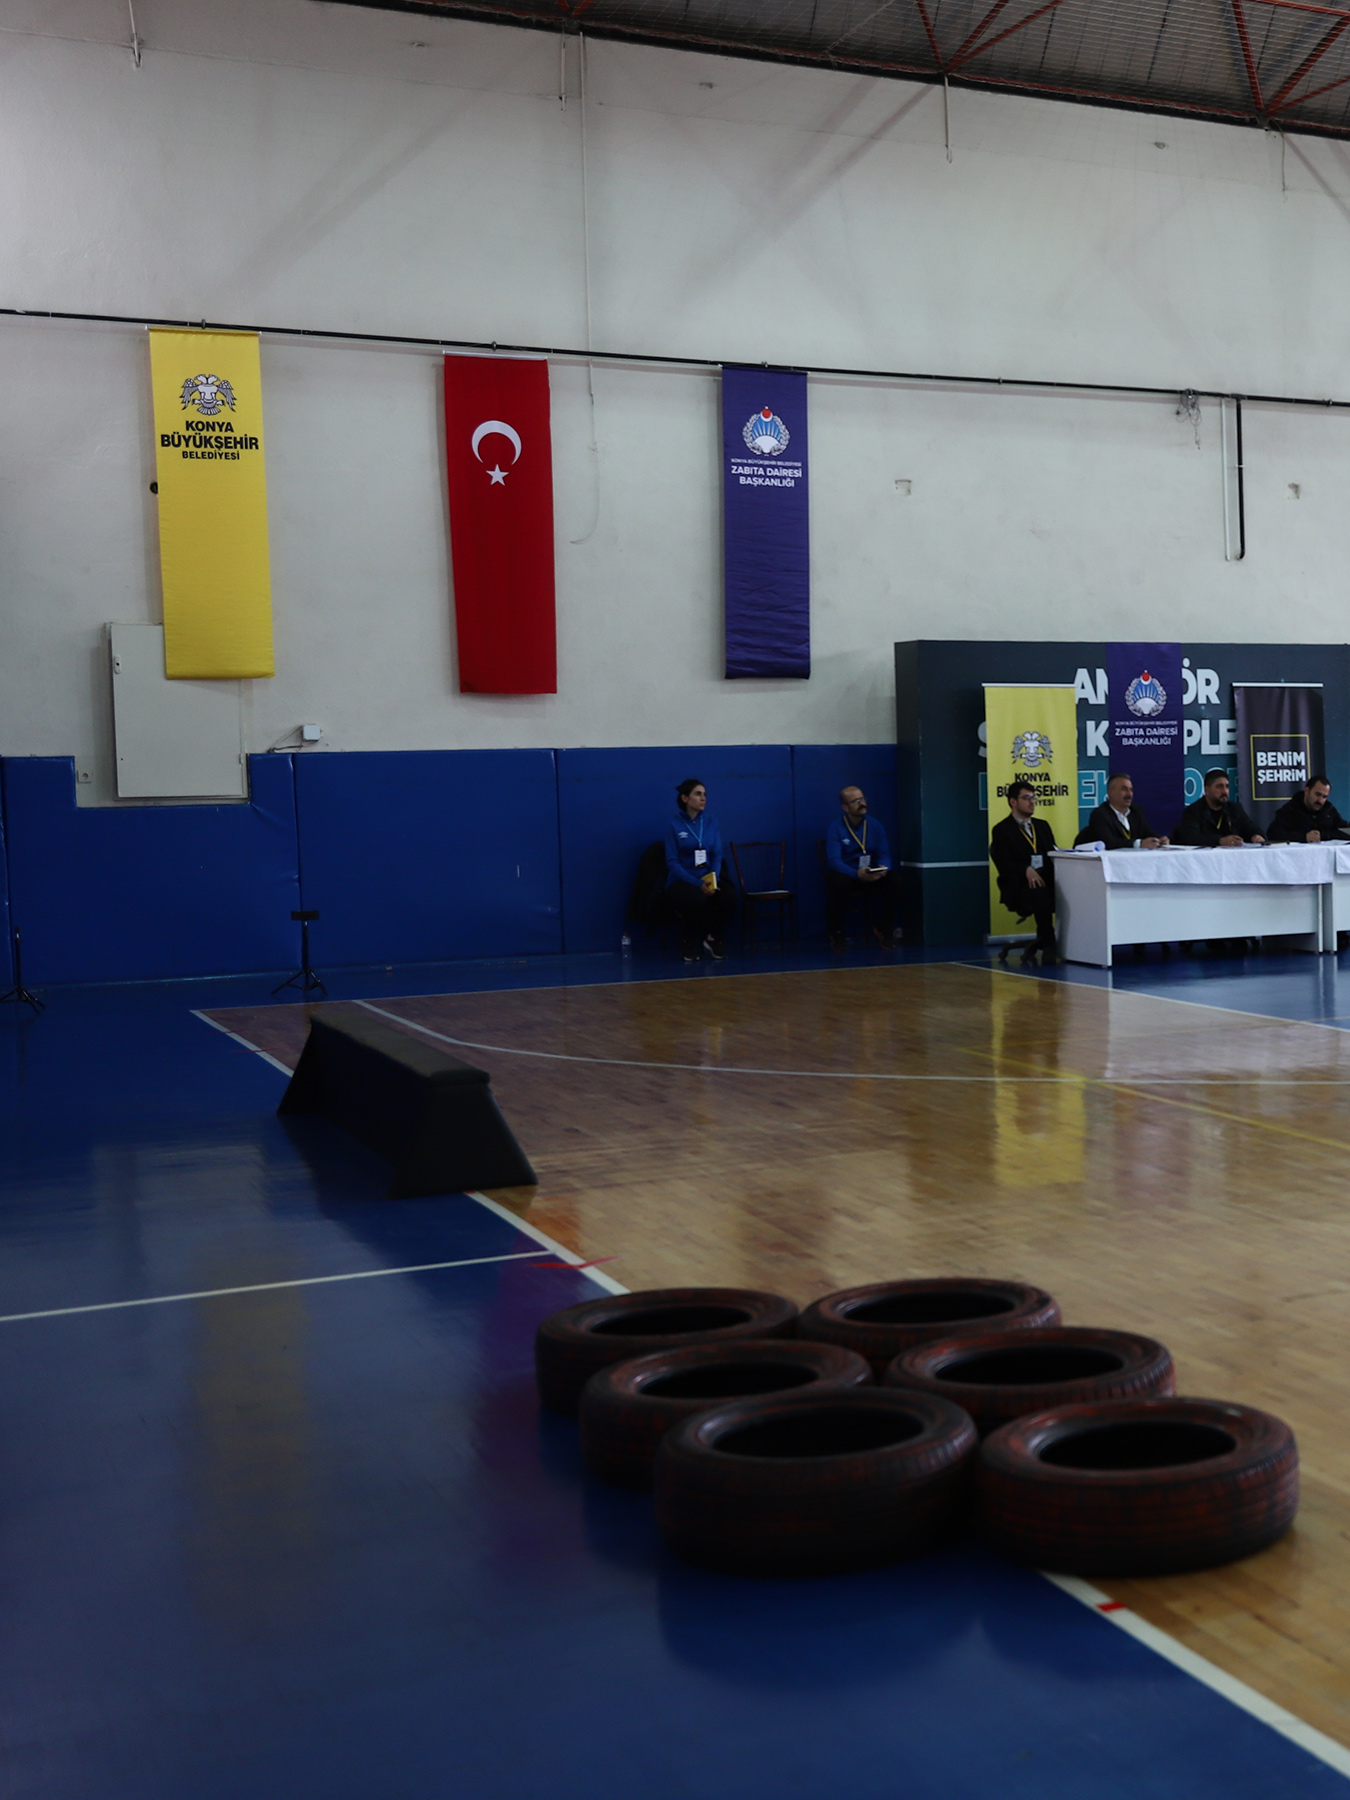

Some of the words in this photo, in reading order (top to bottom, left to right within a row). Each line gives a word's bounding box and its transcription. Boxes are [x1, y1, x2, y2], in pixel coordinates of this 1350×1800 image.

[185, 420, 234, 433] KONYA
[160, 432, 259, 450] BÜYÜKŞEHİR
[182, 450, 240, 460] BELEDİYESİ
[731, 466, 765, 475] ZABITA
[766, 468, 802, 477] DAİRESİ
[739, 476, 795, 487] BAŞKANLIĞI
[1115, 728, 1145, 736] ZABITA
[1146, 726, 1178, 736] DAİRESİ
[1122, 736, 1171, 747] BAŞKANLIĞI
[1014, 772, 1051, 783] KONYA
